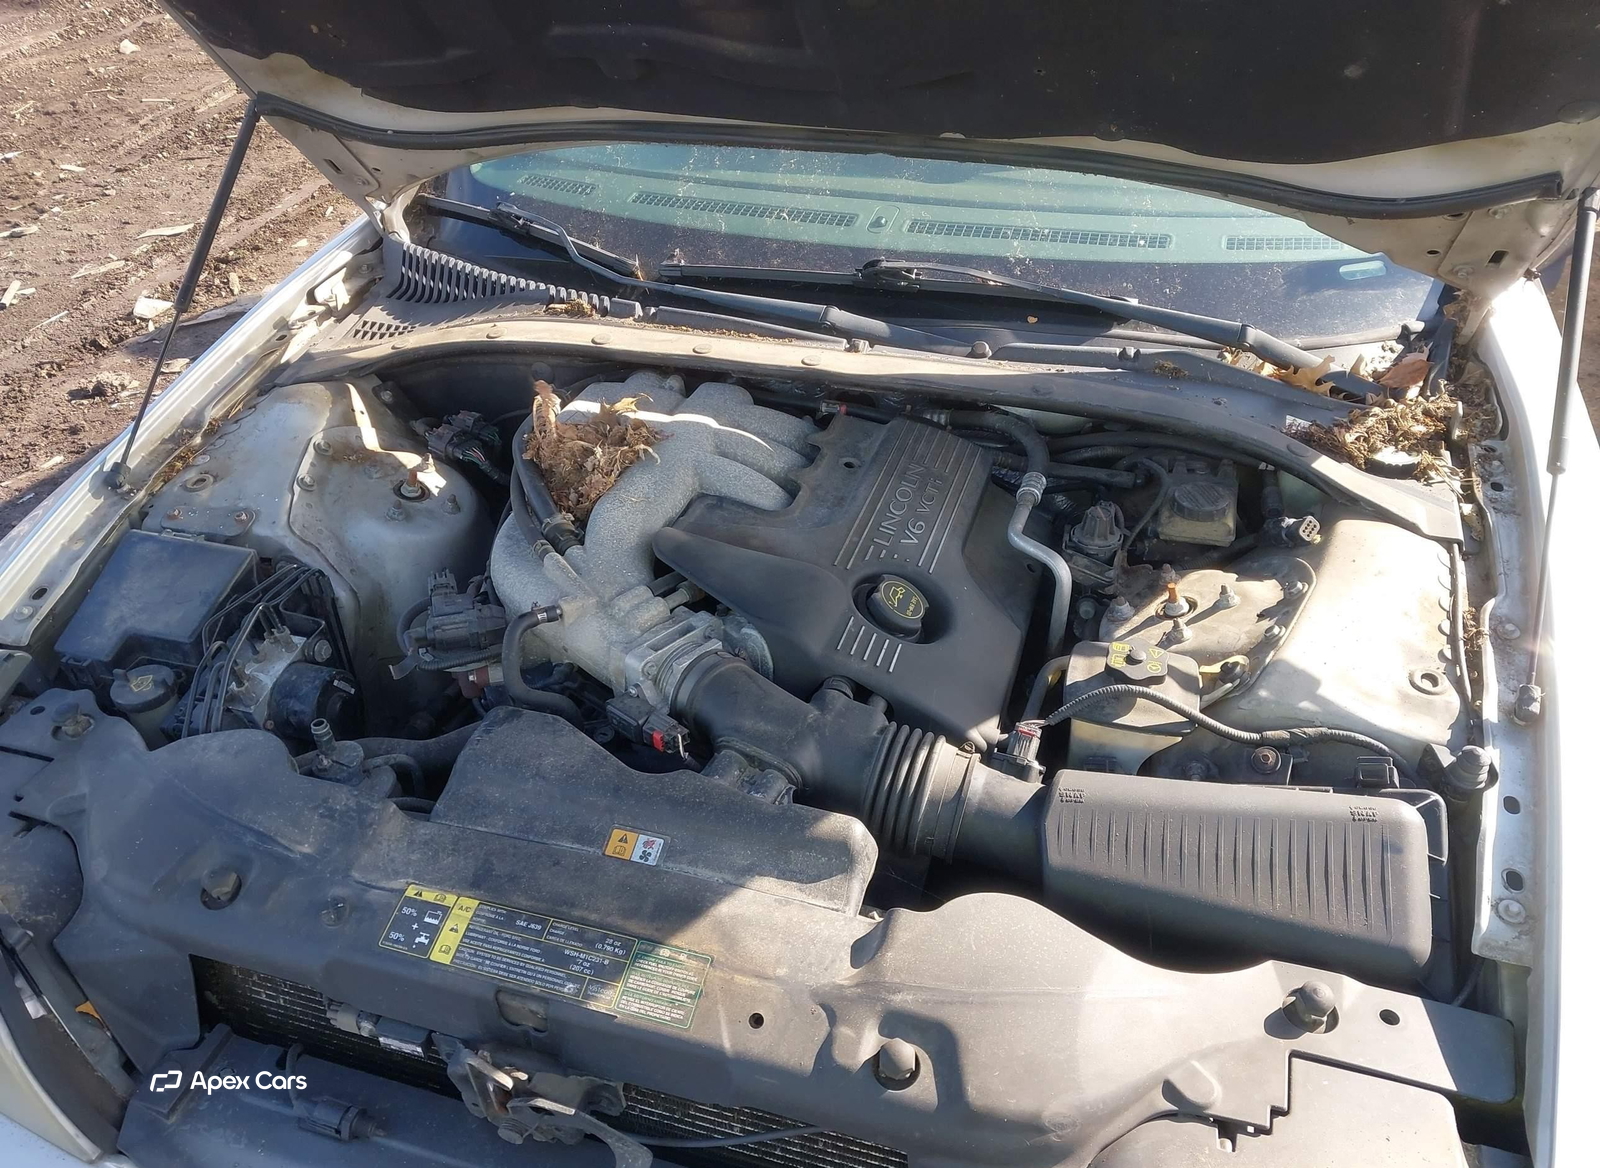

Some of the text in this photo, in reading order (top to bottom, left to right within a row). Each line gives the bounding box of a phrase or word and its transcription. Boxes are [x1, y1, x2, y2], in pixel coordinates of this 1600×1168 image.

[873, 463, 924, 546] LINCOLN
[900, 477, 942, 544] V6 VCTi
[402, 906, 418, 917] 50%
[458, 905, 472, 913] A/C
[388, 932, 405, 942] 50%
[594, 943, 627, 956] (0.790 Kg)
[569, 964, 595, 976] (207 cc)
